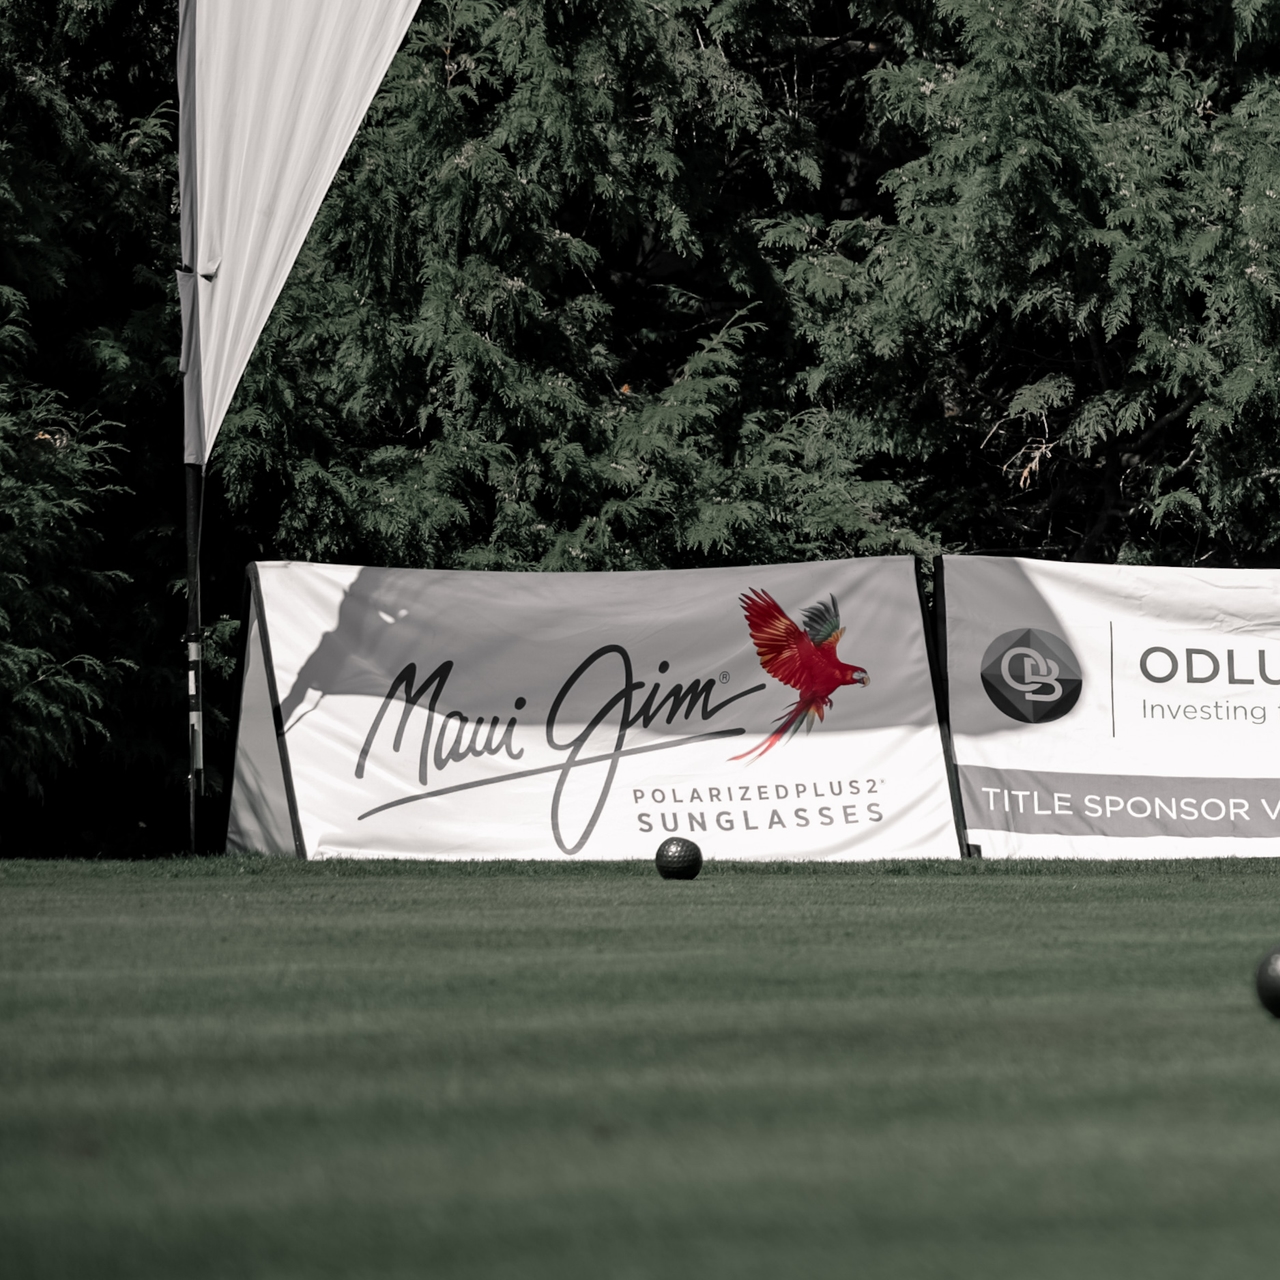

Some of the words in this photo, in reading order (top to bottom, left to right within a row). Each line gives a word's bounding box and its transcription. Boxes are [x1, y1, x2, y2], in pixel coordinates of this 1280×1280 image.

[1142, 699, 1267, 725] Investing
[354, 660, 525, 785] Maui
[545, 644, 766, 856] Jim
[632, 778, 879, 804] POLARIZEDPLUS2
[981, 787, 1074, 816] TITLE
[1083, 794, 1251, 821] SPONSOR
[637, 802, 884, 833] SUNGLASSES
